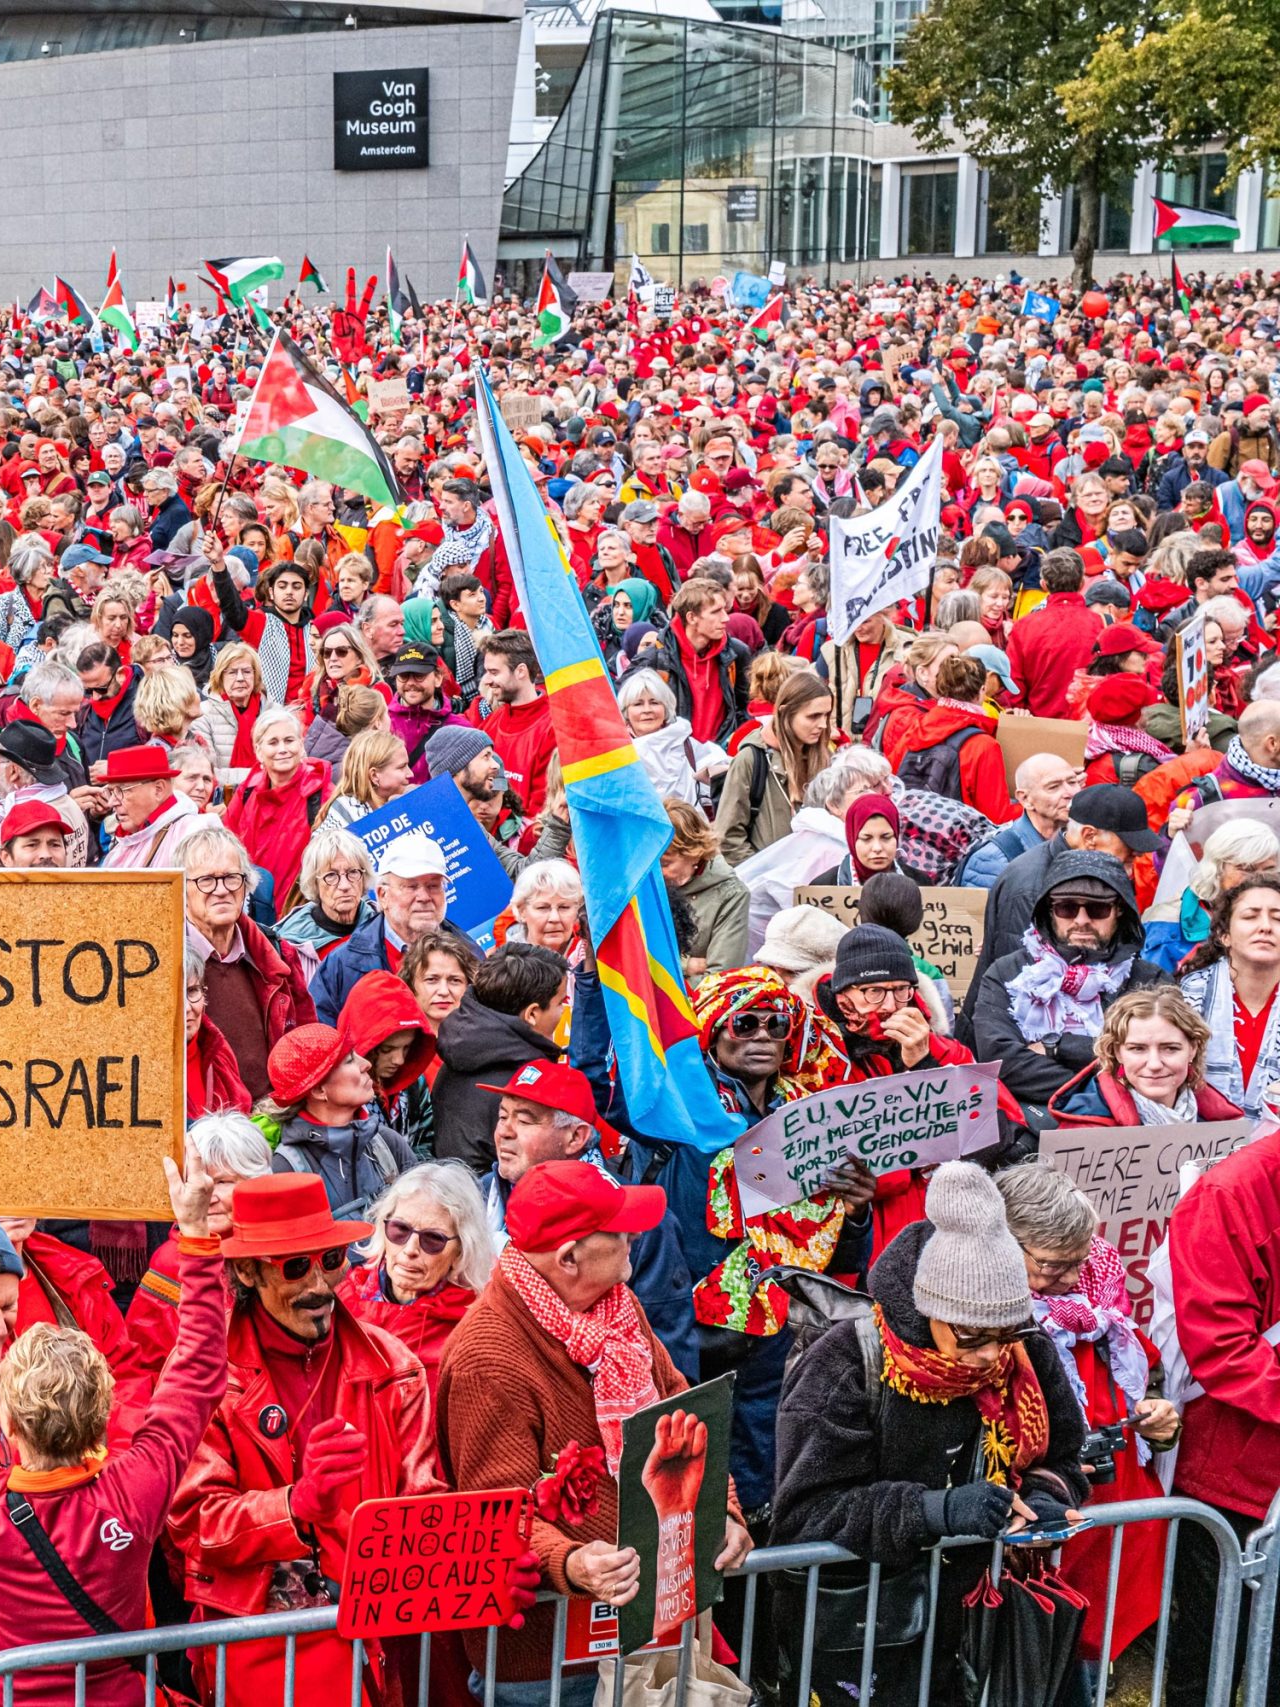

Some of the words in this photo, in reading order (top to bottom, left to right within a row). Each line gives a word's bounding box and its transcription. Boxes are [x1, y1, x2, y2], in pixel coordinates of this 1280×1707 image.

[382, 81, 415, 97] Van
[369, 99, 415, 117] Gogh
[346, 120, 415, 136] Museum
[360, 145, 415, 156] Amsterdam
[844, 526, 893, 557] FREE
[390, 813, 412, 833] DE
[835, 1091, 877, 1119] VS
[884, 1094, 903, 1104] en
[904, 1079, 949, 1101] VN
[1055, 1144, 1151, 1184] THERE
[660, 1511, 693, 1533] NIEMAND
[358, 1524, 503, 1559] GENOCIDE
[671, 1526, 691, 1551] VRIJ
[350, 1557, 517, 1596] HOLOCAUST
[658, 1563, 694, 1597] PALESTINA
[352, 1597, 382, 1628] IN
[395, 1591, 502, 1623] GAZA
[659, 1595, 680, 1621] VRIJ
